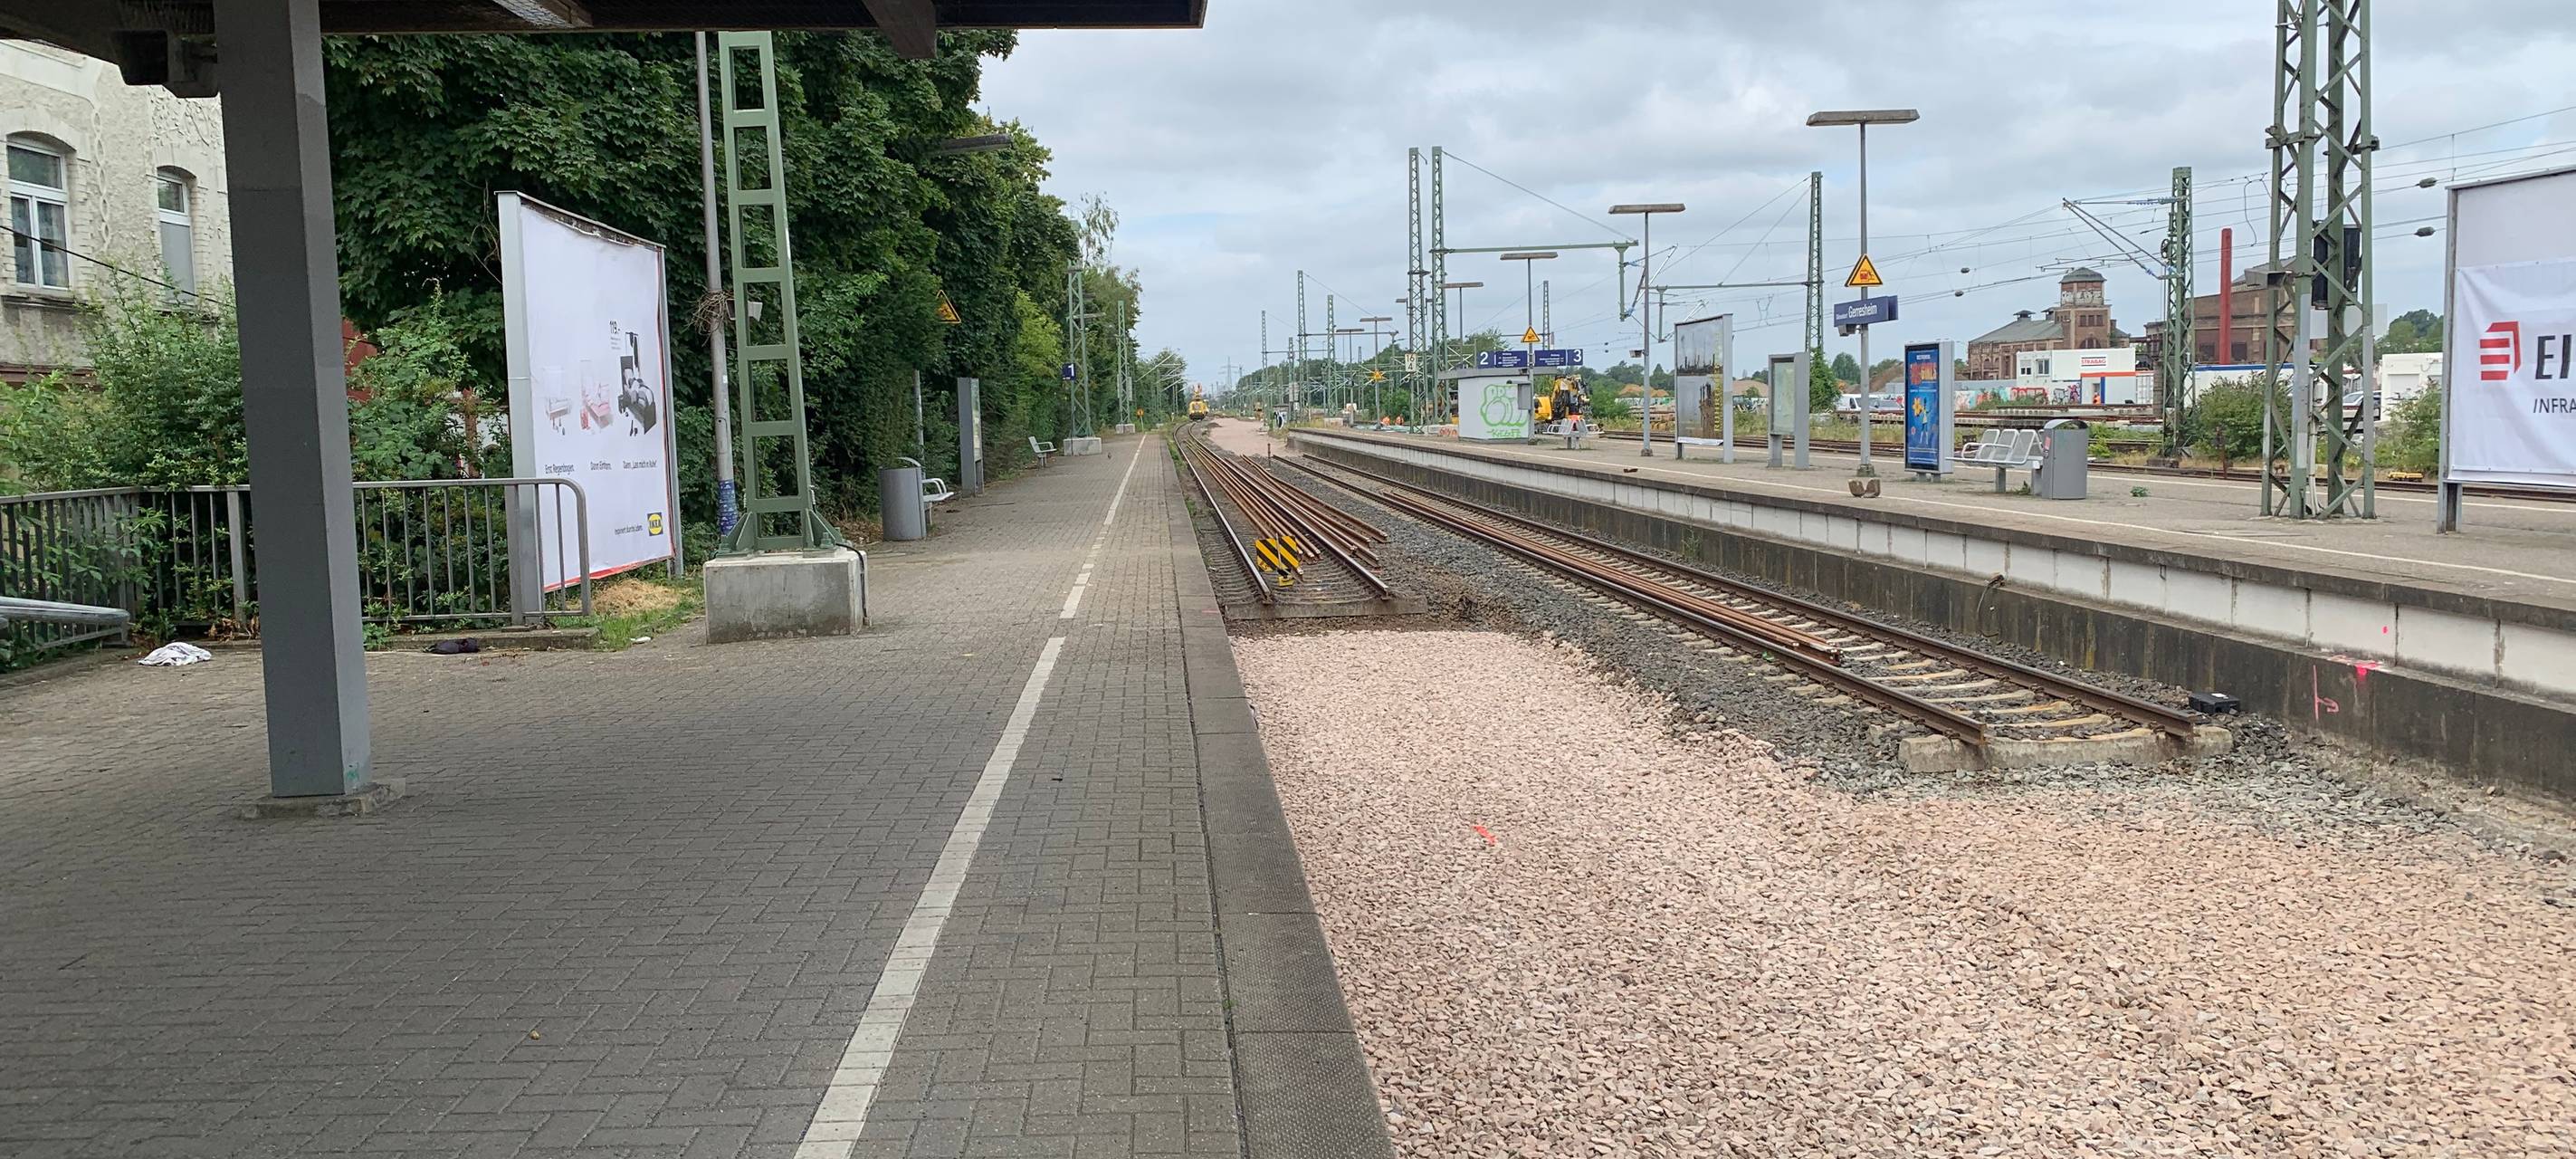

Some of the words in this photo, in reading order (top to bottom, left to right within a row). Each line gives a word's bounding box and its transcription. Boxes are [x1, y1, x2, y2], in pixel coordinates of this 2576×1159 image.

[1848, 302, 1877, 318] Gerresheim
[1407, 353, 1415, 362] 16
[1480, 351, 1489, 365] 2
[1573, 349, 1582, 362] 3
[1068, 364, 1074, 376] 1
[649, 520, 662, 529] IKEA
